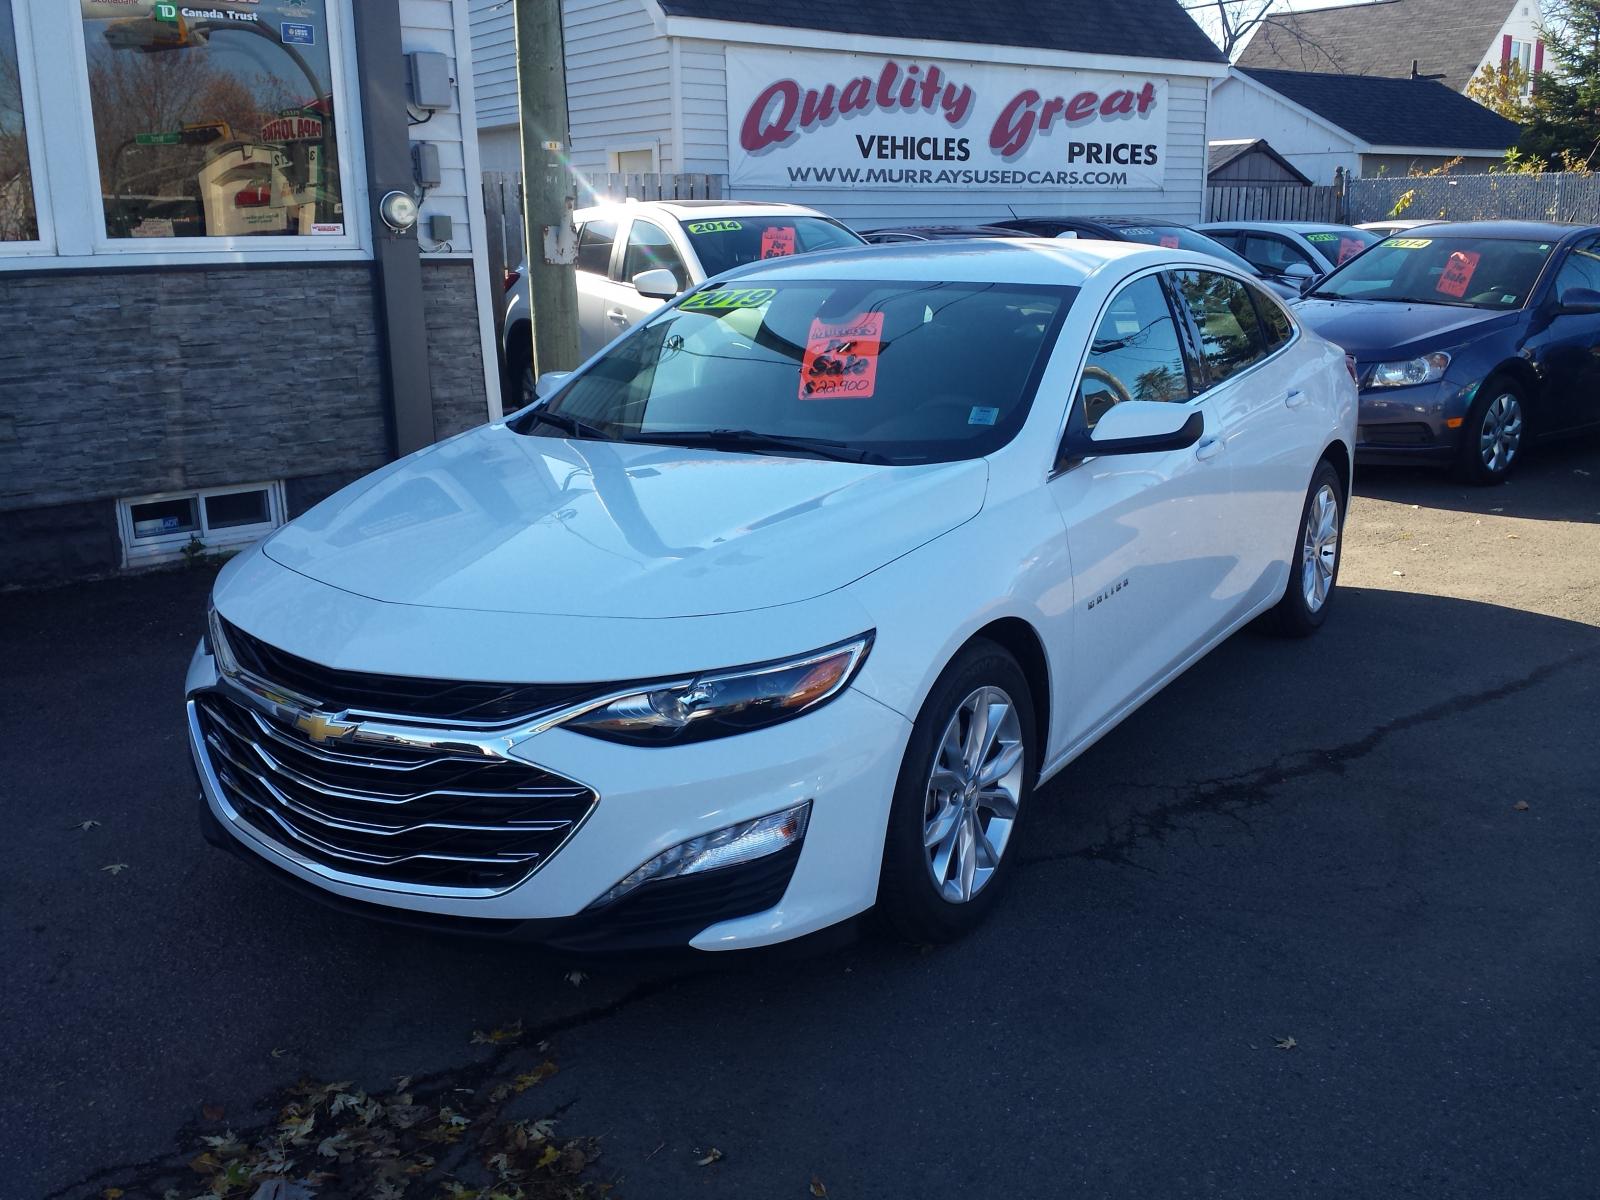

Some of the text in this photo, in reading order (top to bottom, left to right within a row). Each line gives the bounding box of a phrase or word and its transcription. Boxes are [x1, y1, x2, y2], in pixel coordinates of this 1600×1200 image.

[160, 4, 258, 22] TD Canada Trust
[741, 60, 1156, 158] Quality Great
[855, 134, 1158, 166] VEHICLES PRICES
[786, 166, 1128, 186] WWW.MURRAYSUSEDCARS.COM
[693, 221, 739, 233] 2014
[771, 240, 786, 249] For
[682, 289, 772, 307] 2019
[809, 354, 870, 377] Sale
